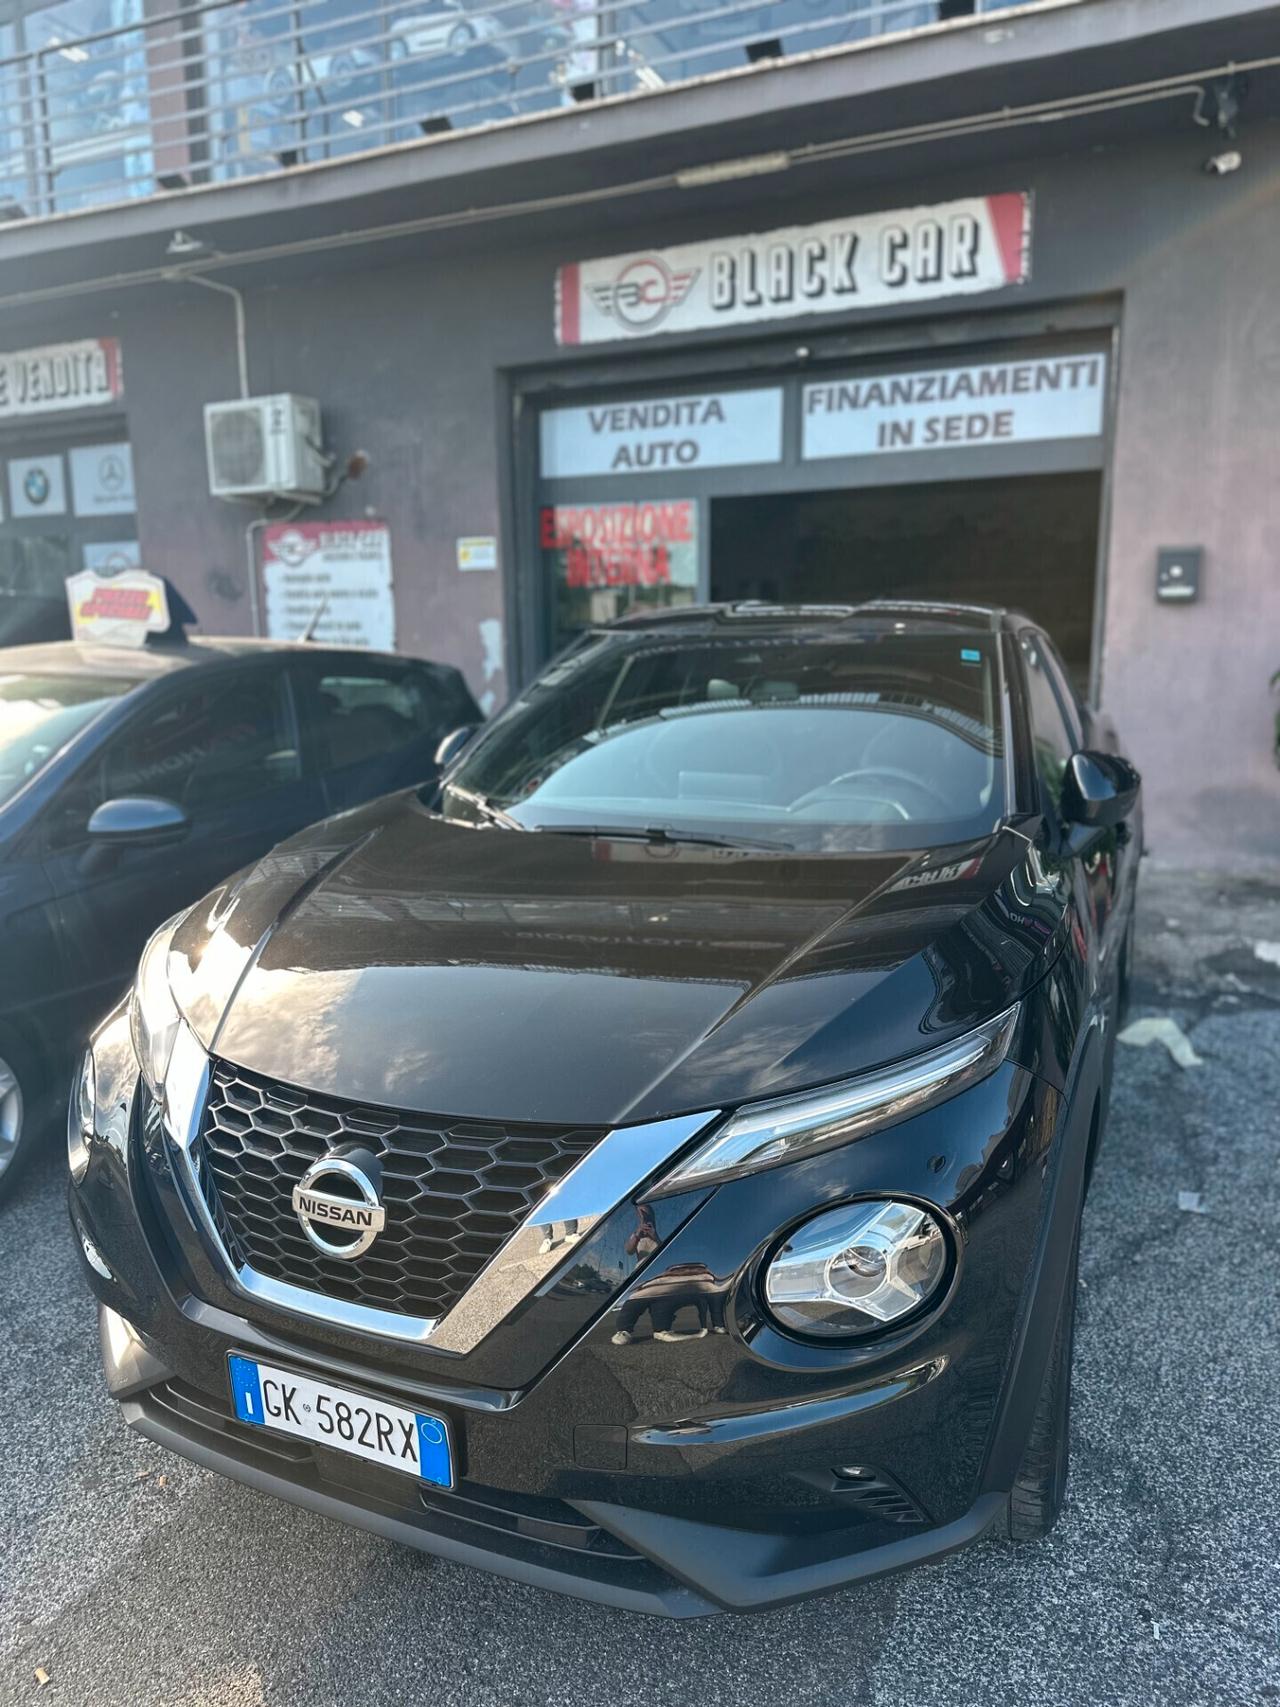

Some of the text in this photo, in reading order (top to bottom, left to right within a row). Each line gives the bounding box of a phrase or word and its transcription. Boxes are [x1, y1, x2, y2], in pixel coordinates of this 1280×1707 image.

[711, 214, 980, 310] BLACK CAR
[13, 351, 110, 404] VENDITA
[806, 359, 1099, 415] FINANZIAMENTI
[588, 398, 726, 434] VENDITA
[876, 409, 1015, 448] IN SEDE
[611, 439, 701, 469] AUTO
[299, 1196, 372, 1226] NISSAN
[262, 1379, 302, 1426] GK
[315, 1393, 418, 1463] 582RX
